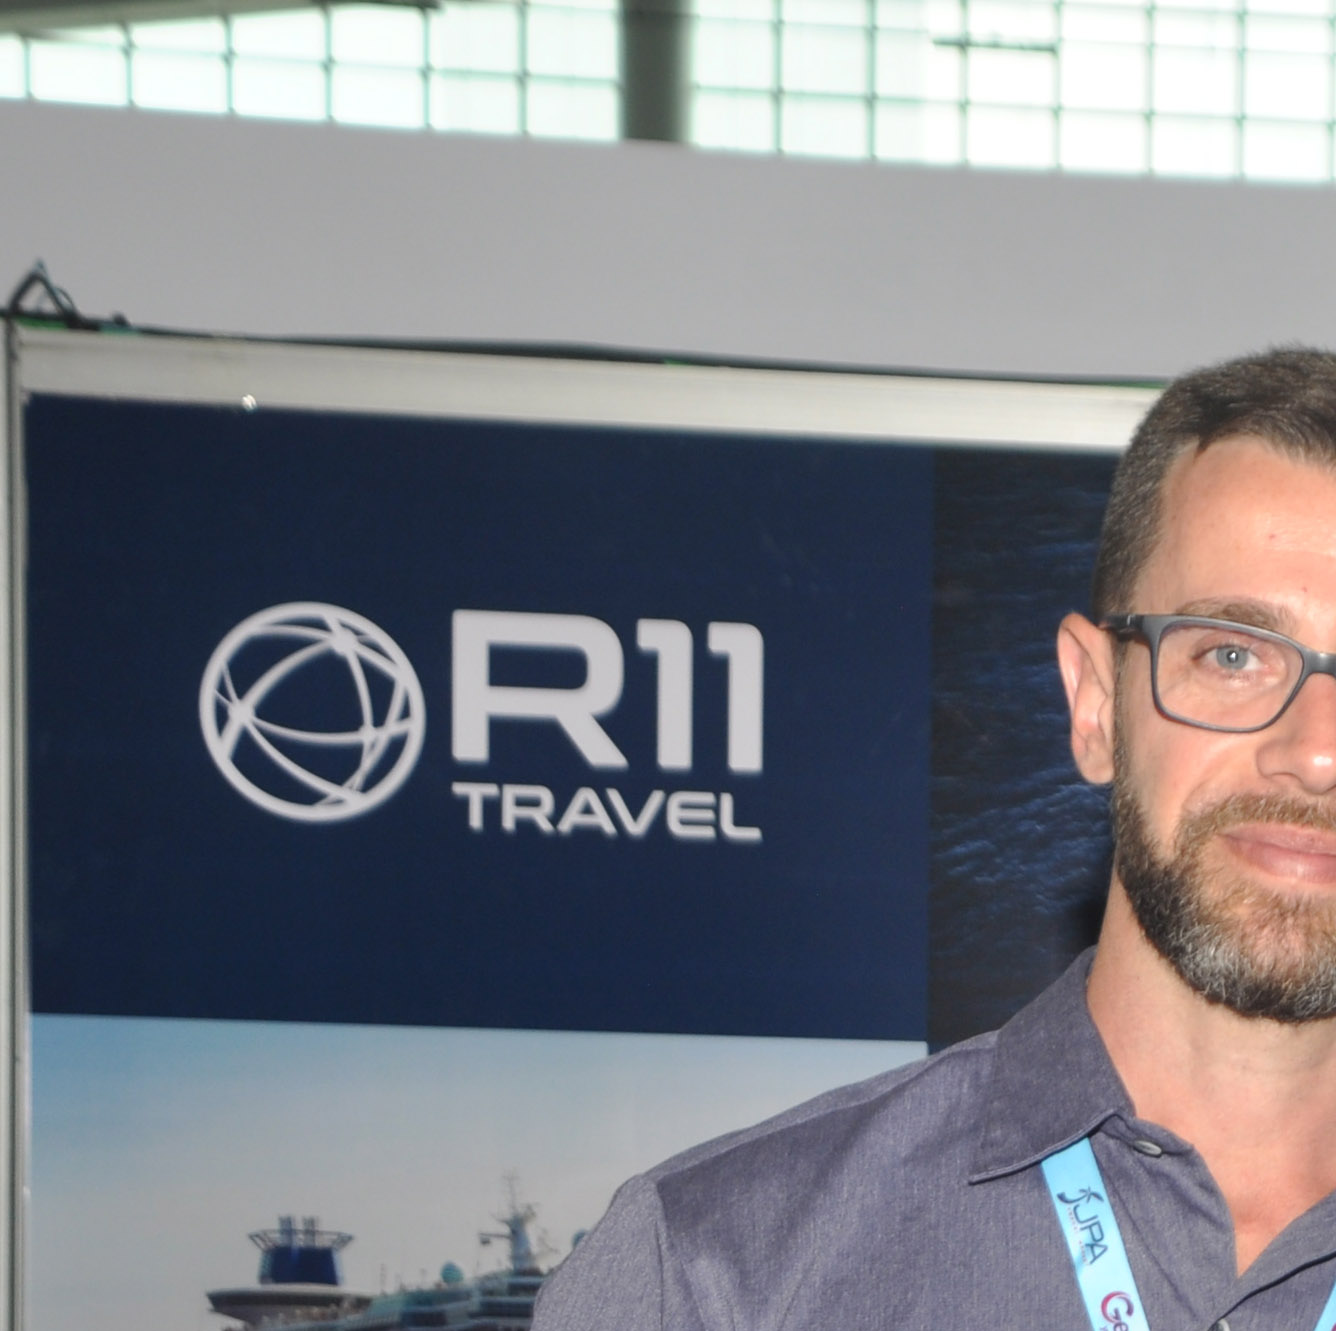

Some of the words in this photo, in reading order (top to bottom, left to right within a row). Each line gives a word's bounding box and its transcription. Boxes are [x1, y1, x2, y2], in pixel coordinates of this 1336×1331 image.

[452, 609, 764, 773] R11
[452, 781, 763, 841] TRAVEL
[1073, 1202, 1108, 1265] JPA
